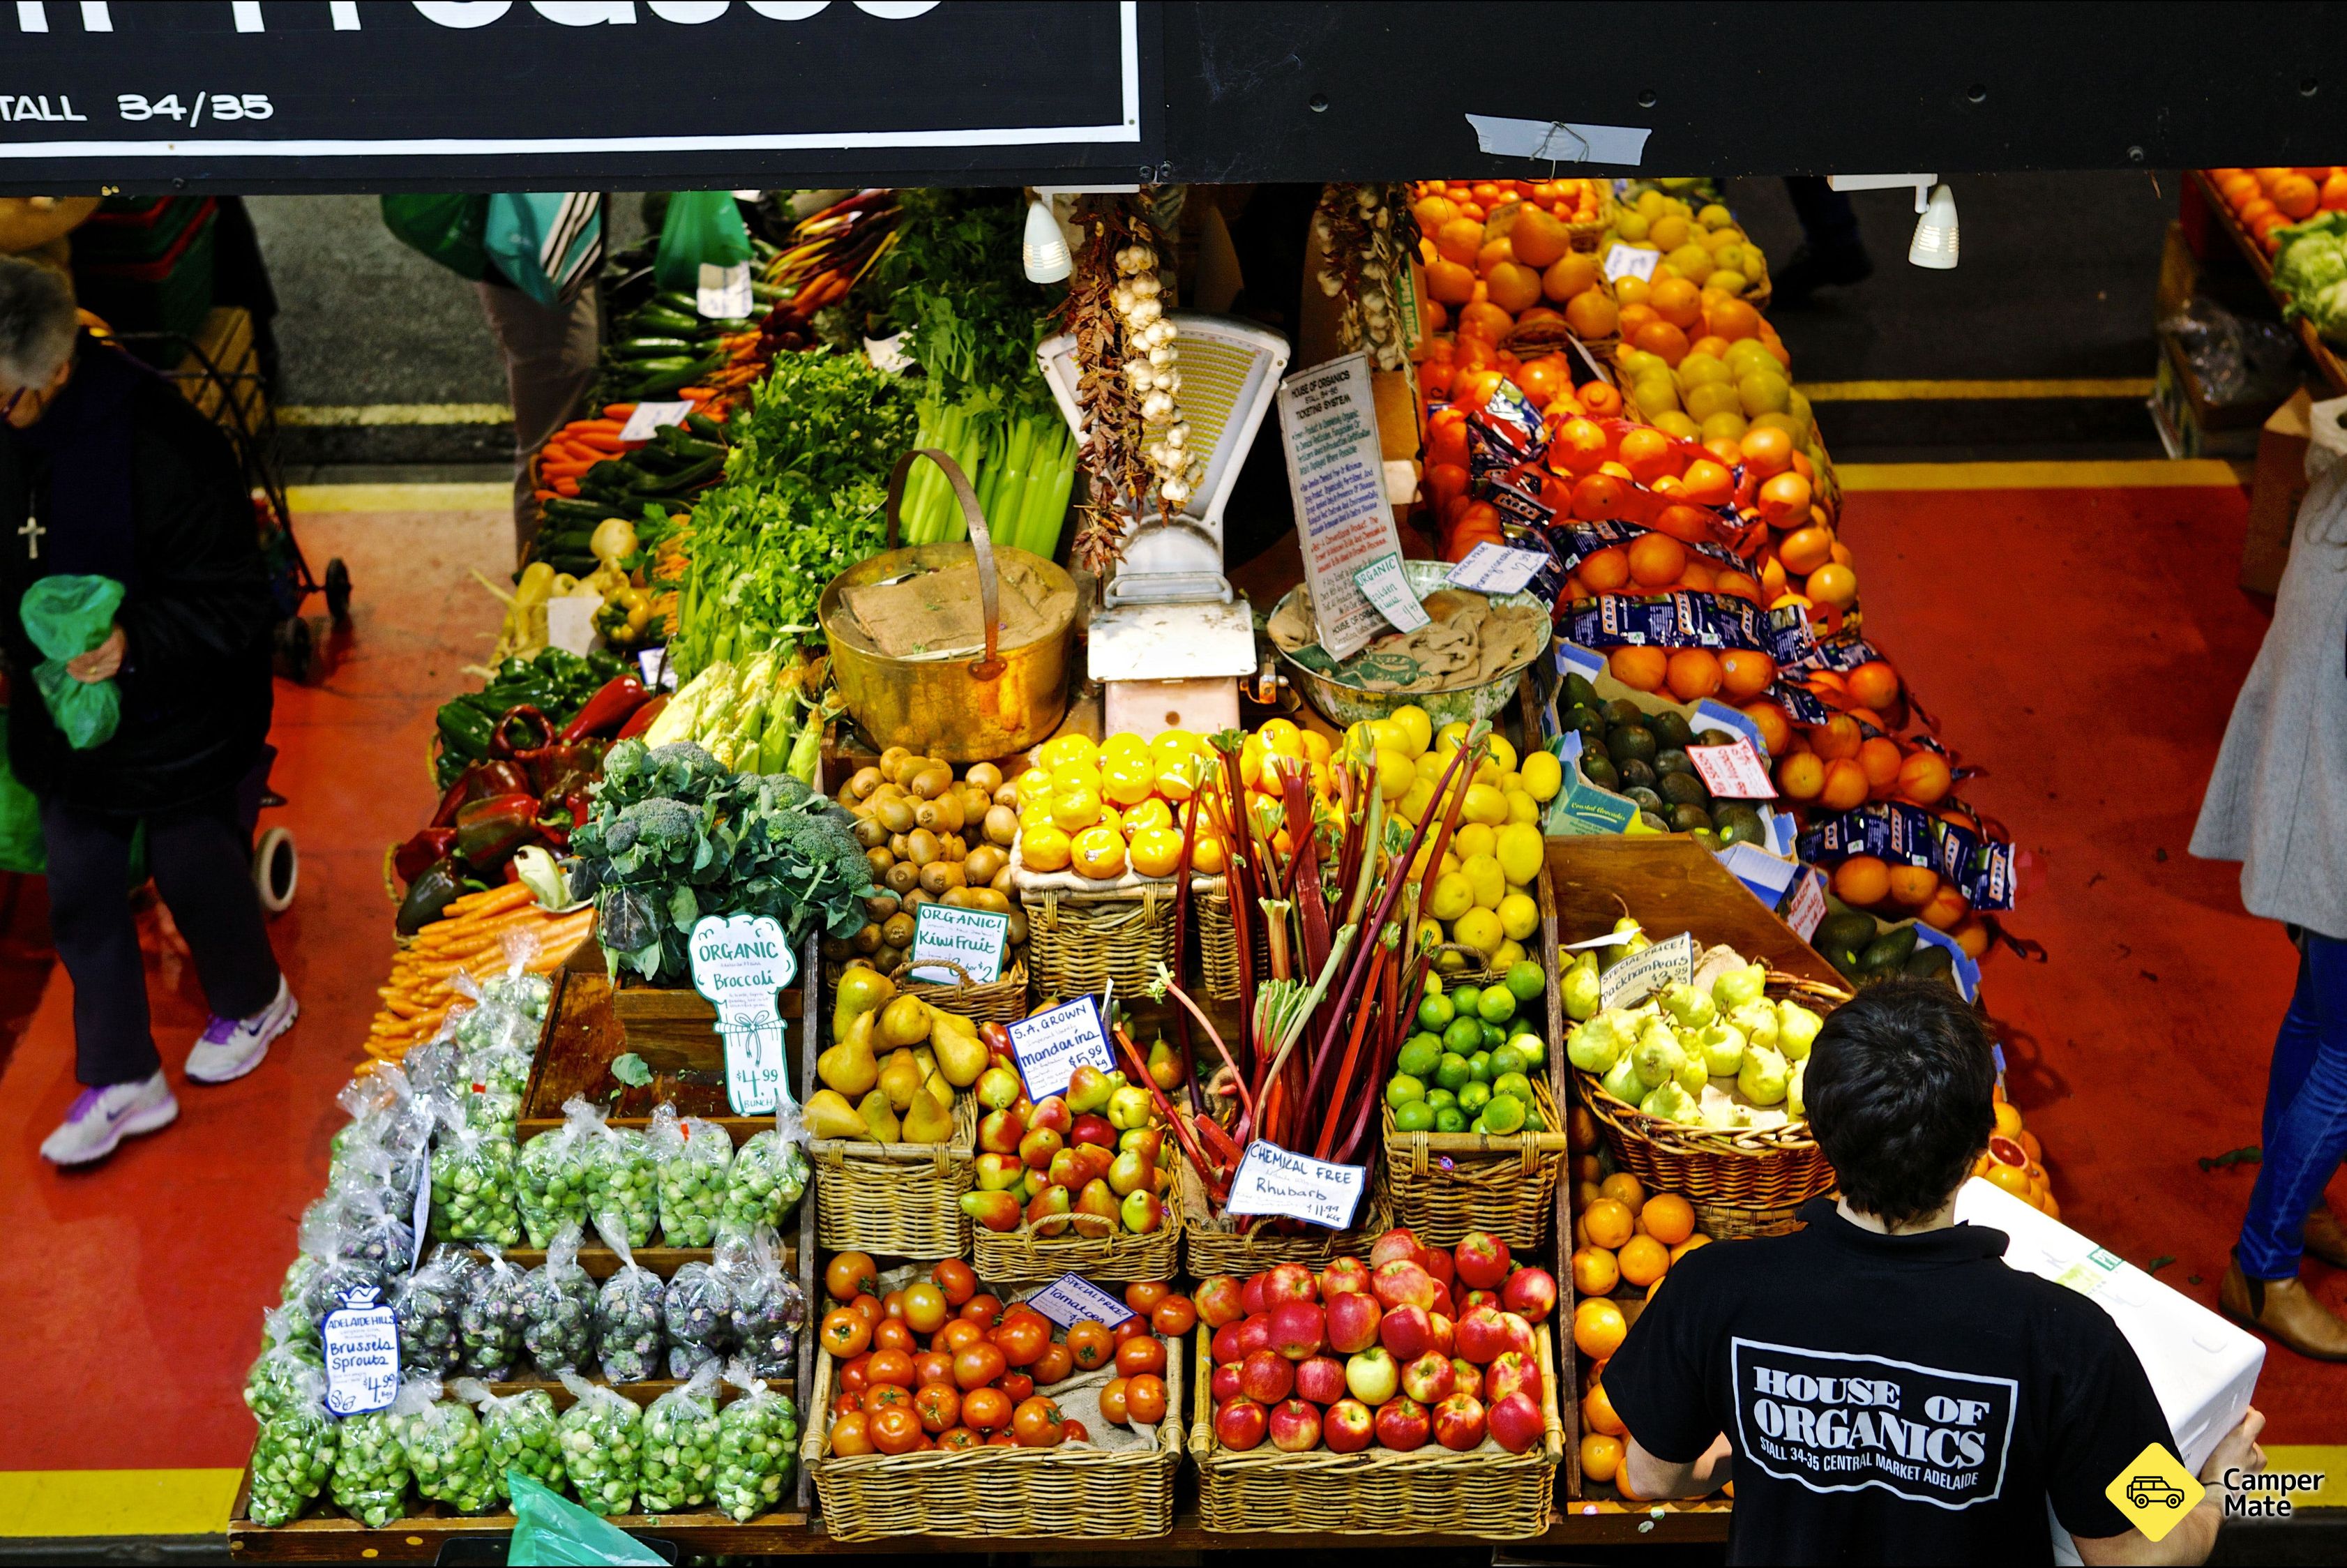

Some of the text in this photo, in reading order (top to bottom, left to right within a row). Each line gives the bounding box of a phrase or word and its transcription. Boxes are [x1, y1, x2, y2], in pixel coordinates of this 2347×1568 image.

[117, 91, 274, 128] 34/35
[1290, 370, 1350, 398] HOUSE OF ORGANICS
[1295, 393, 1351, 419] TICKETING SYSTEM
[1356, 559, 1396, 587] ORGANIC
[1368, 582, 1398, 605] Golden
[1331, 615, 1359, 634] HOUSE OF
[922, 908, 1002, 933] ORGANIC!
[699, 941, 779, 963] ORGANIC
[919, 930, 996, 954] Kiwi Fruit
[714, 970, 776, 991] Broccoli
[1603, 956, 1641, 985] SPECIAL
[1014, 1004, 1087, 1040] S.A. GROWN
[1095, 1058, 1108, 1069] kg
[744, 1099, 773, 1109] BUNCH
[1249, 1144, 1352, 1184] CHEMICAL FREE
[1256, 1177, 1328, 1200] Rhubarb
[1048, 1286, 1105, 1324] Tomatoes
[1063, 1276, 1098, 1299] SPECIAL
[1098, 1297, 1129, 1318] PRICE!
[327, 1315, 397, 1329] ADELAIDE HILLS
[330, 1337, 395, 1356] Brussels
[331, 1355, 390, 1373] Sprouts
[1753, 1366, 1990, 1426] HOUSE OF
[1753, 1399, 1986, 1470] ORGANICS
[1760, 1435, 1979, 1490] STALL 34-35 CENTRAL MARKET ADELAIDE
